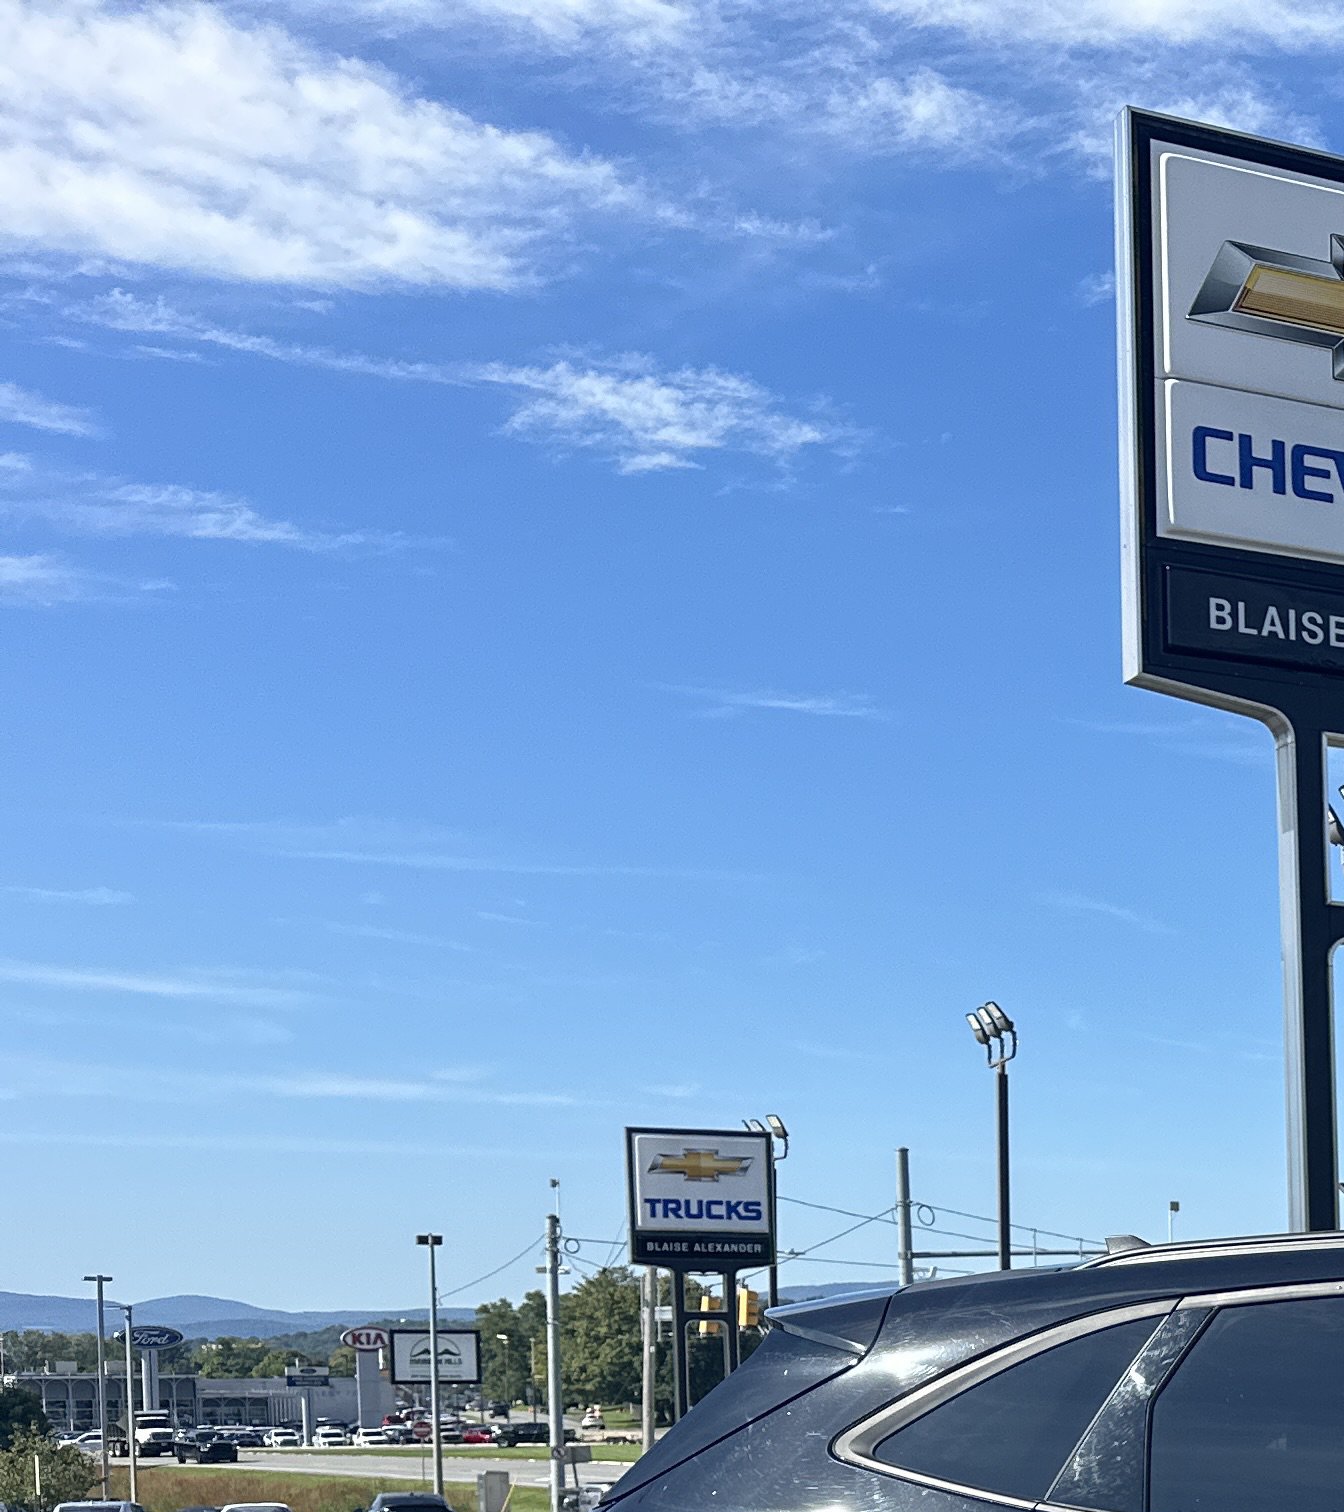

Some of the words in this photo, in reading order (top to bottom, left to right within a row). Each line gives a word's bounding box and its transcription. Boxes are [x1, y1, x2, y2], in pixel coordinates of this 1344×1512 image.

[644, 1198, 762, 1221] TRUCKS
[647, 1241, 689, 1252] BLAISE
[693, 1242, 762, 1253] ALEXANDER
[132, 1330, 170, 1345] Ford
[351, 1332, 386, 1346] KIA
